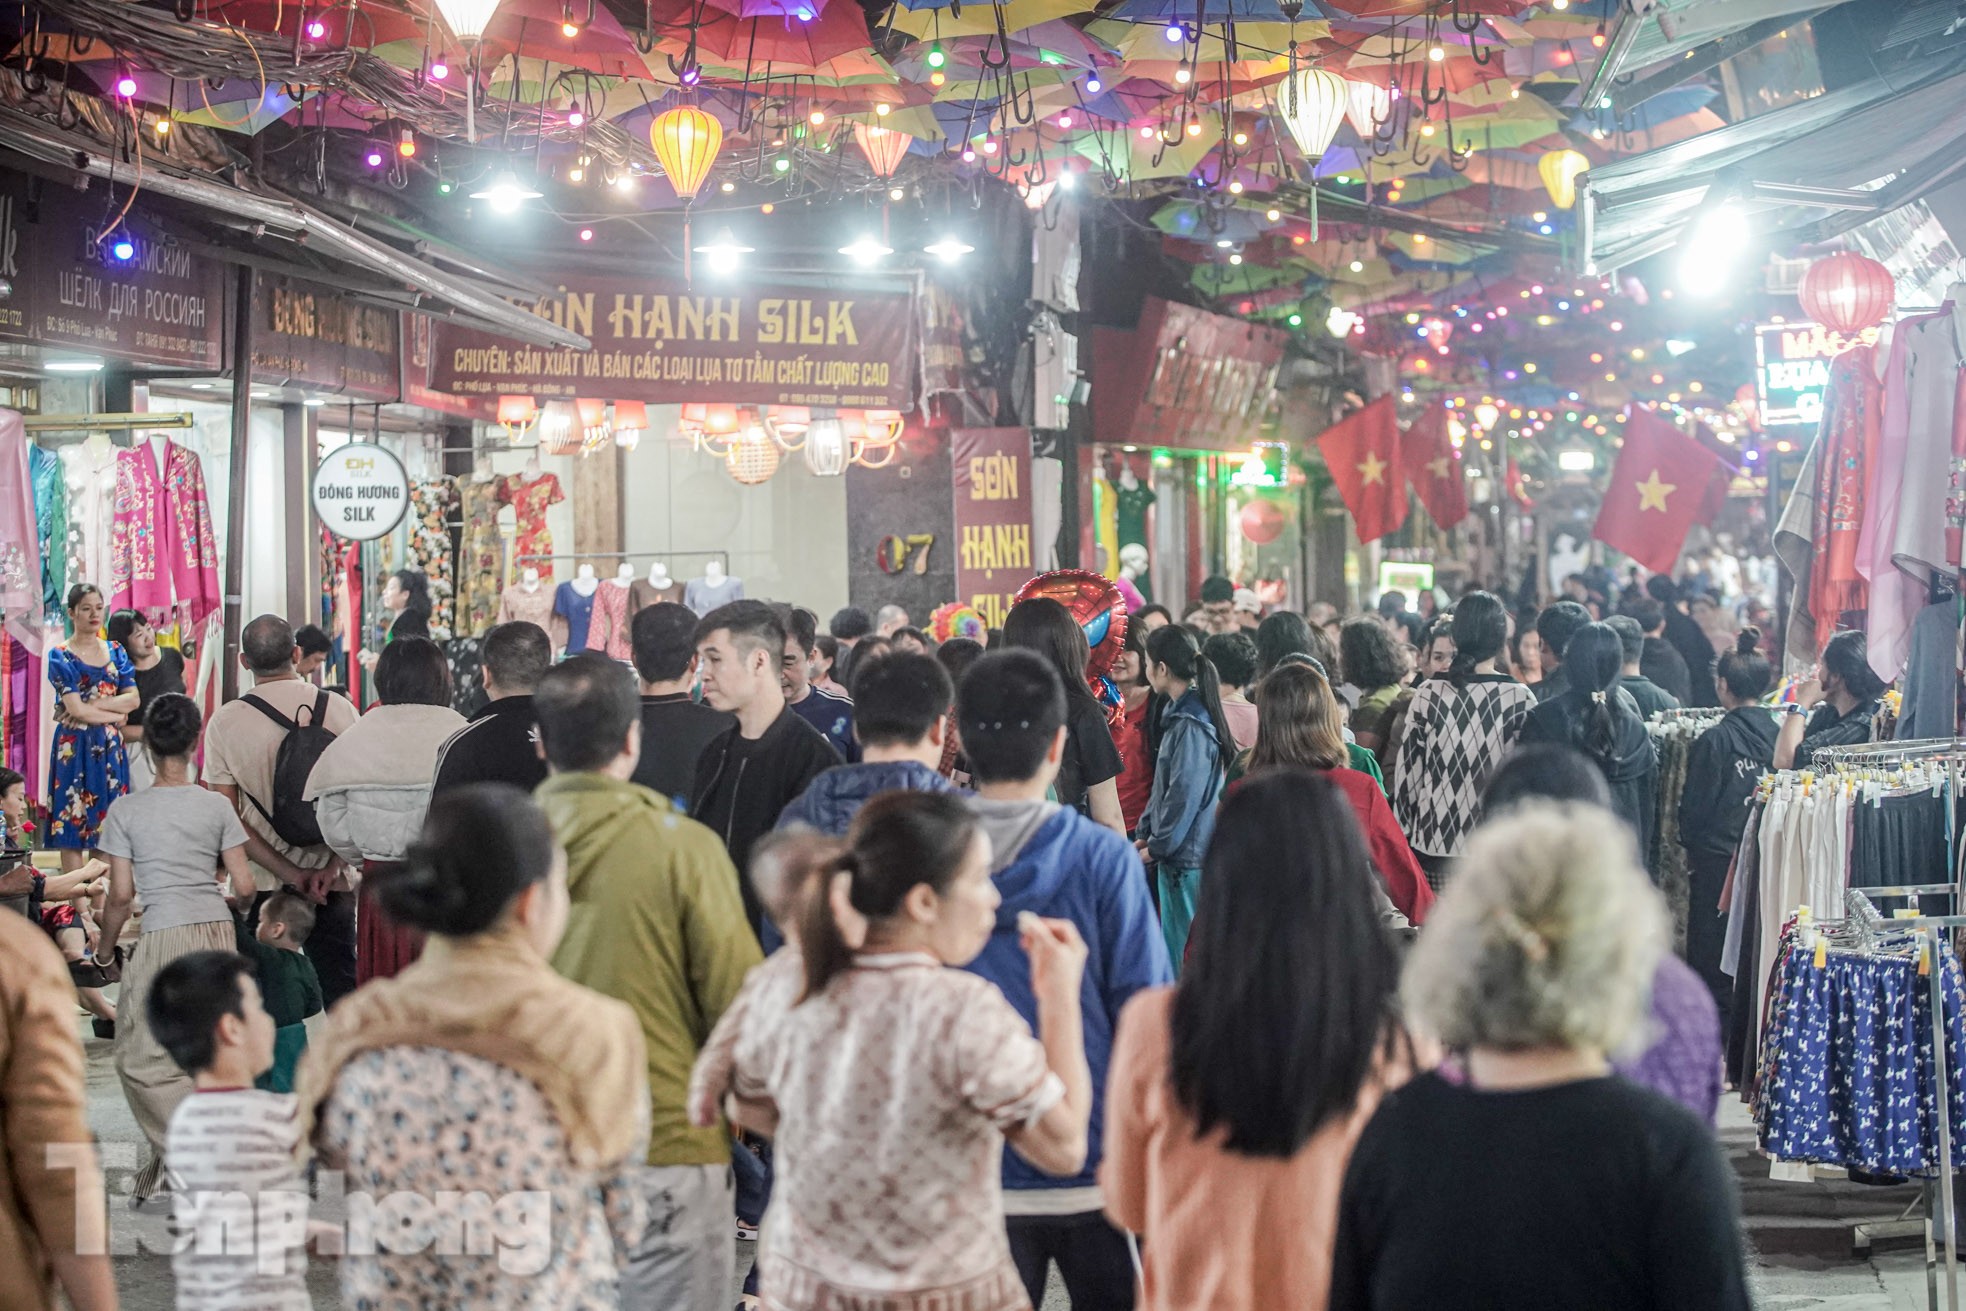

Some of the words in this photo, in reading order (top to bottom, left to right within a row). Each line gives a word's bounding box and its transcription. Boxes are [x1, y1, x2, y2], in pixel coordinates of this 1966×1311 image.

[59, 267, 102, 311] ШЁЛК
[108, 282, 138, 322] ДЛЯ
[145, 288, 206, 328] РОССИЯН
[608, 292, 742, 350] HẠNH
[757, 298, 859, 346] SILK
[453, 344, 512, 375] CHUYÊN:
[513, 343, 543, 375] SẢN
[544, 346, 582, 377] XUẤT
[582, 348, 601, 377] VÀ
[603, 349, 632, 378] BÁN
[632, 350, 662, 381] CÁC
[663, 355, 694, 385] LOẠI
[695, 356, 722, 386] LỤA
[724, 357, 744, 382] TƠ
[777, 353, 814, 385] CHẤT
[814, 360, 860, 391] LƯỢNG
[861, 362, 889, 387] CAO
[319, 483, 354, 499] ĐÔNG
[357, 484, 400, 500] HƯƠNG
[970, 449, 1019, 500] SƠN
[343, 506, 376, 522] SILK
[876, 533, 935, 576] 07
[960, 523, 1032, 580] HẠNH
